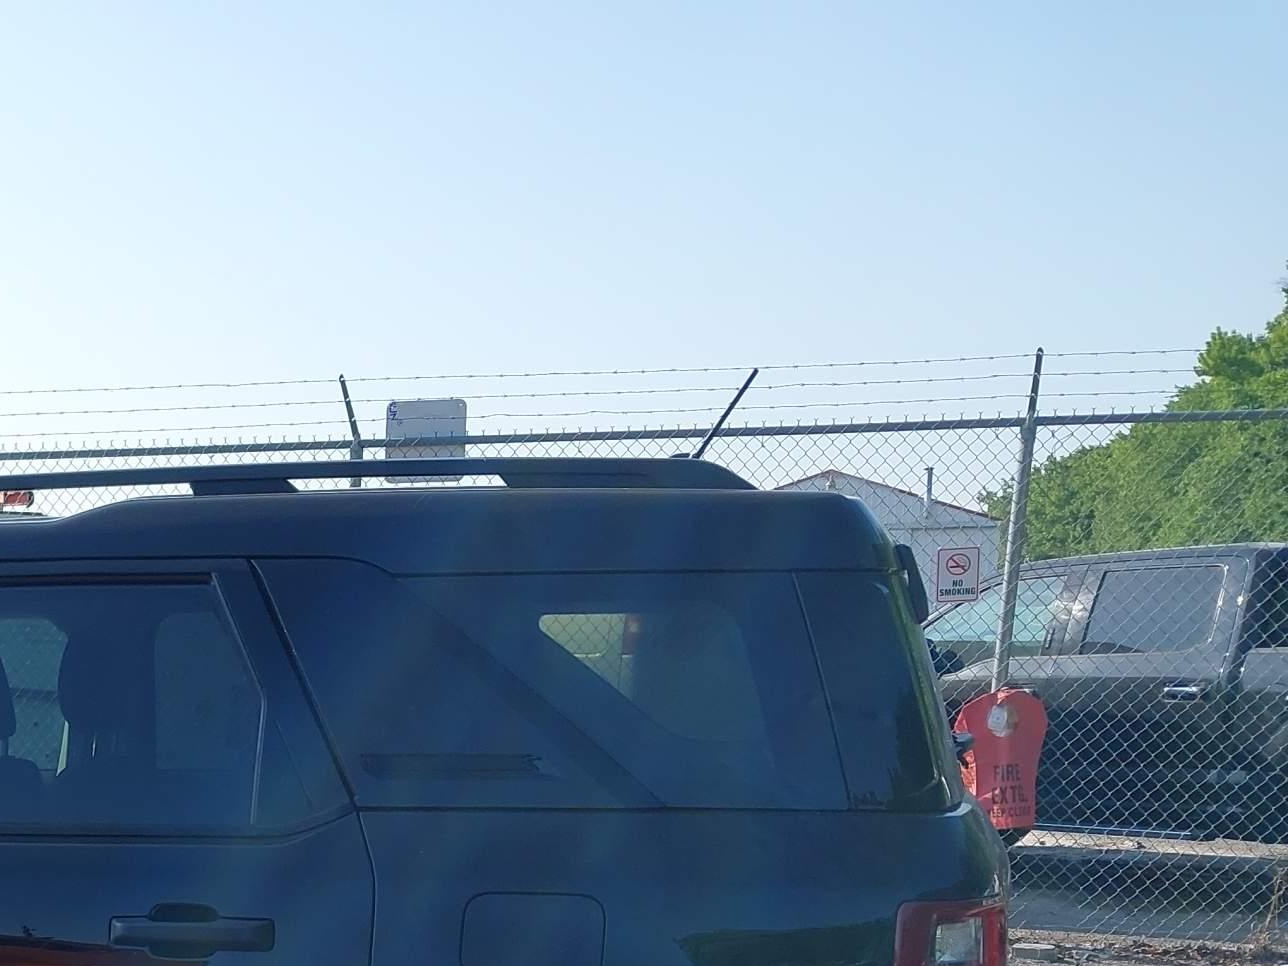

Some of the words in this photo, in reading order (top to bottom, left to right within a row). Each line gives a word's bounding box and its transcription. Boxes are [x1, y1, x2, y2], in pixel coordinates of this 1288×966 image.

[952, 579, 964, 588] NO
[939, 587, 976, 597] SMOKING
[993, 763, 1021, 782] FIRE
